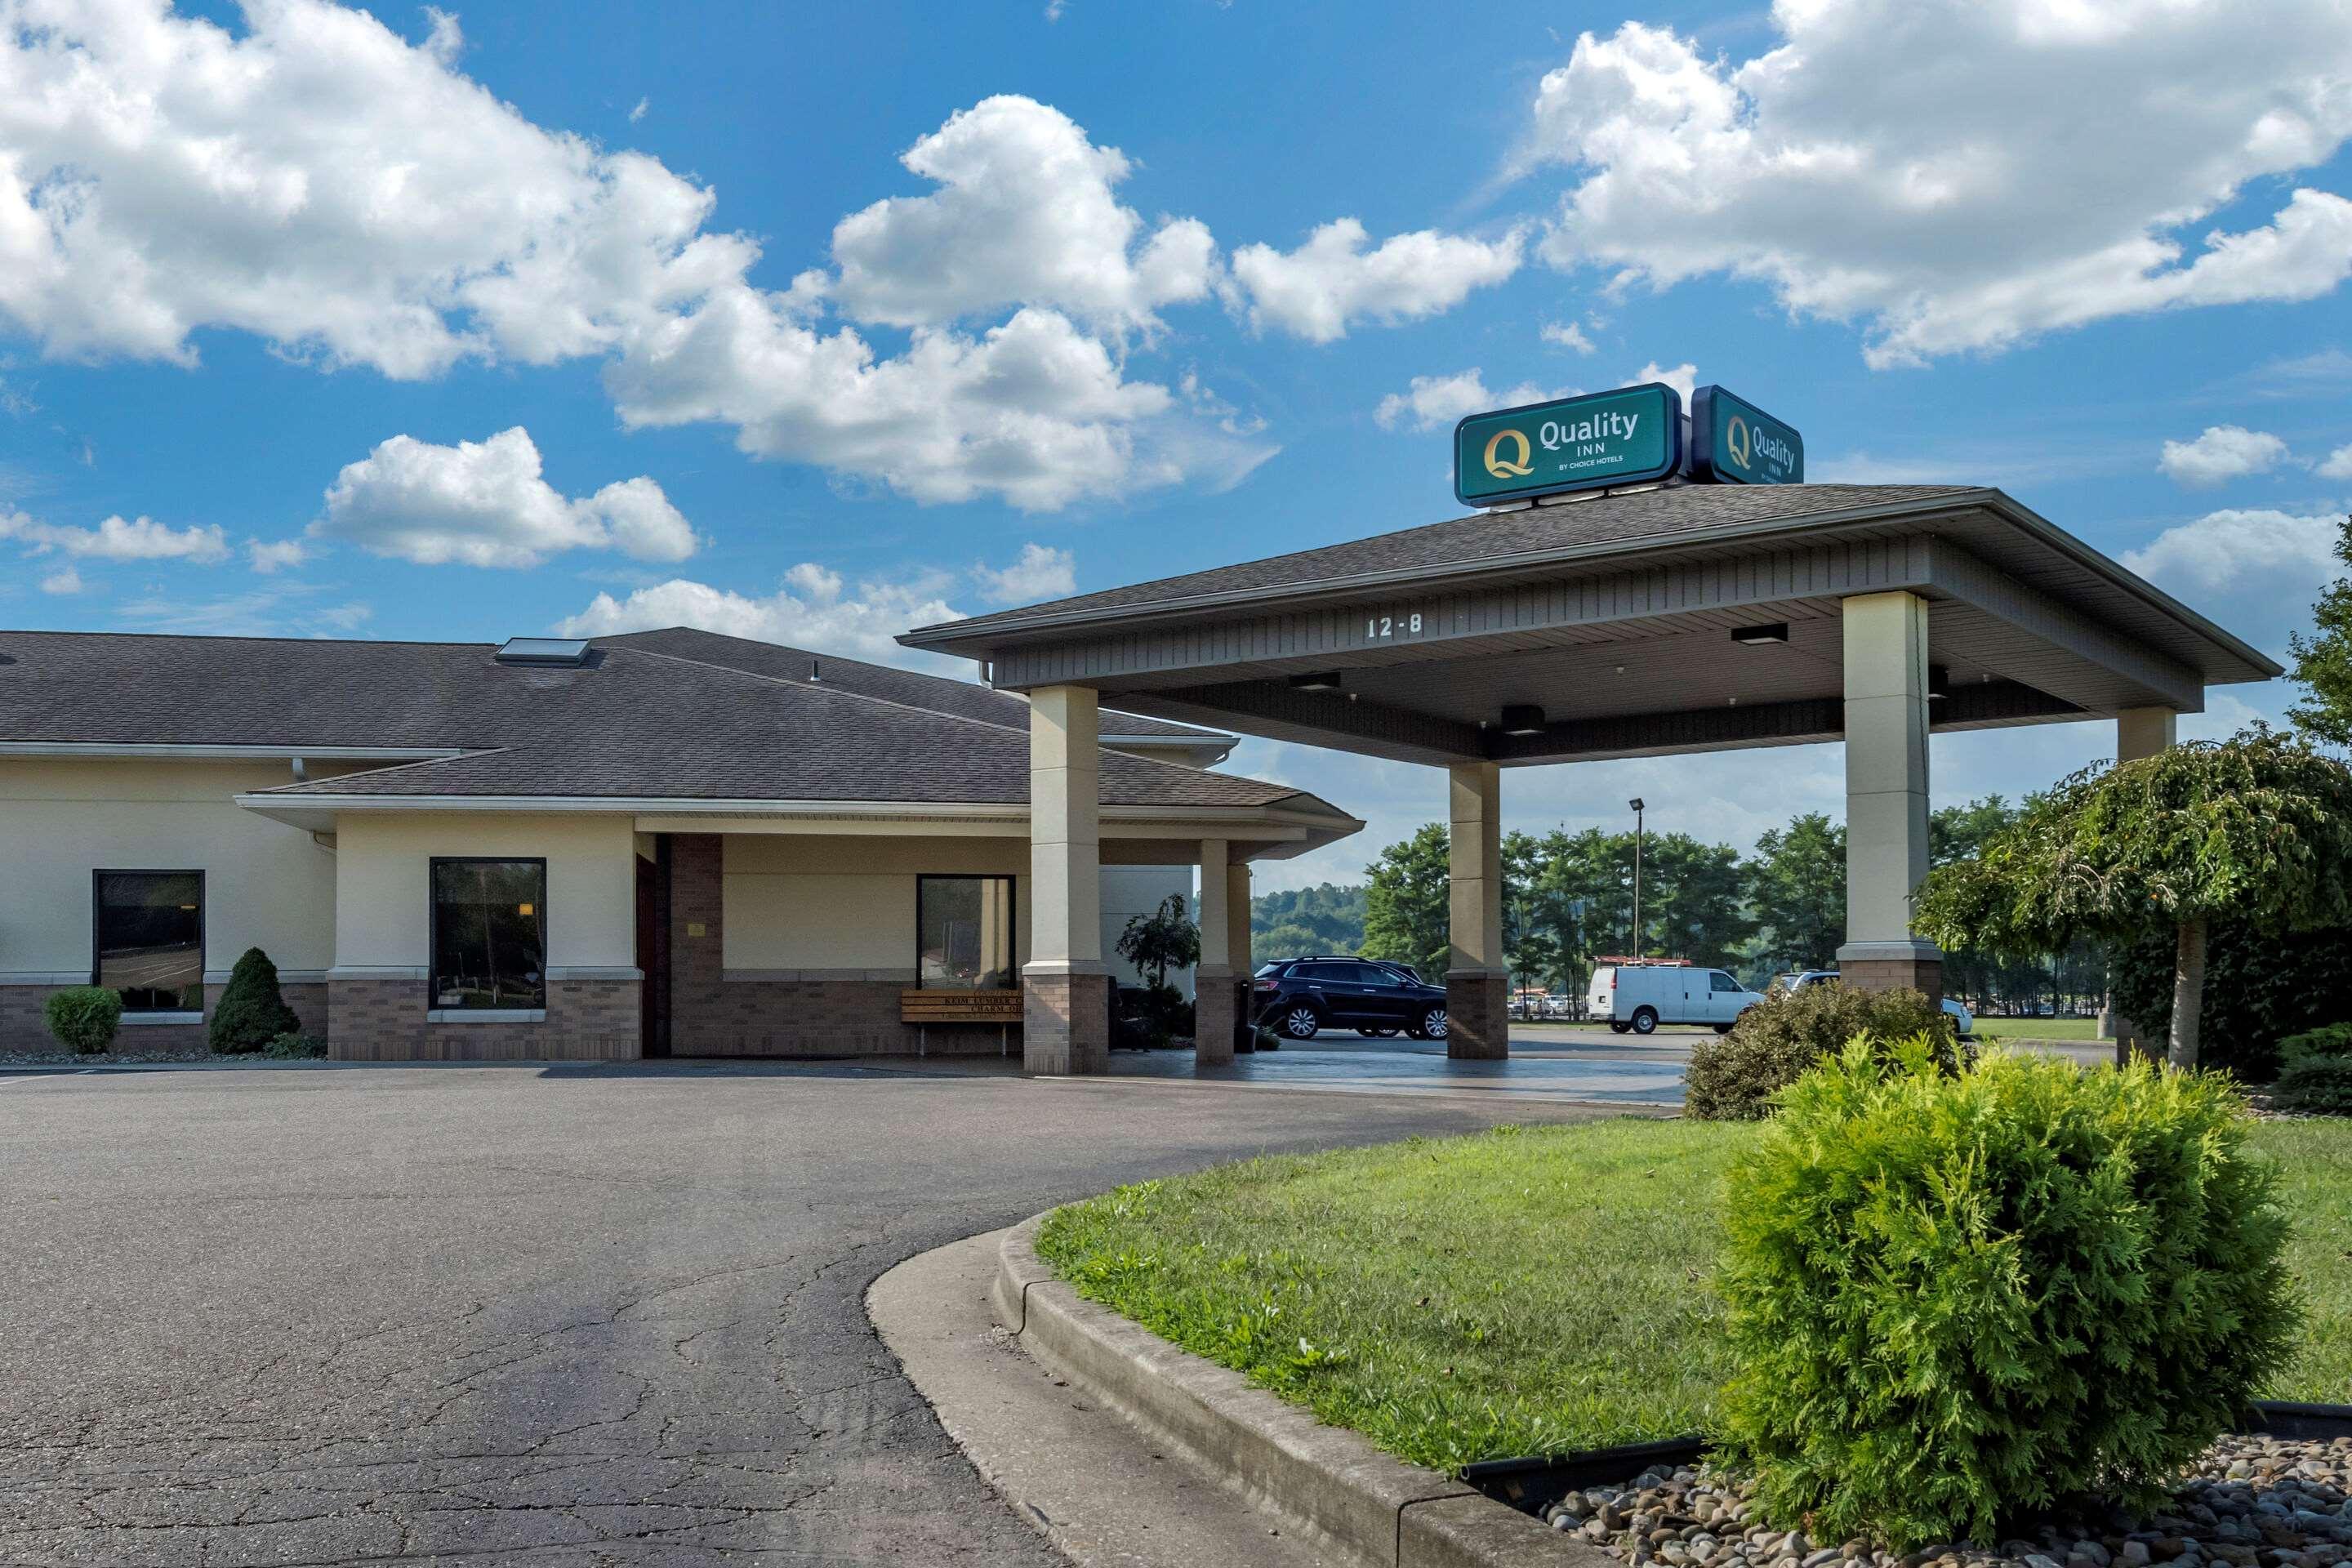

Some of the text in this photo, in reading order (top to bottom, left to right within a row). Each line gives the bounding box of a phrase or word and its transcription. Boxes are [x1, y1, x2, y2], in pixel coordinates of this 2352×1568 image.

[1539, 412, 1638, 451] Quality
[1727, 416, 1751, 470] Q
[1484, 430, 1535, 479] Q
[1570, 459, 1595, 470] CHOICE
[1597, 455, 1624, 466] HOTELS
[1577, 442, 1606, 457] INN
[1753, 426, 1795, 474] Quality
[1768, 462, 1781, 477] INN
[1368, 613, 1422, 638] 12-8
